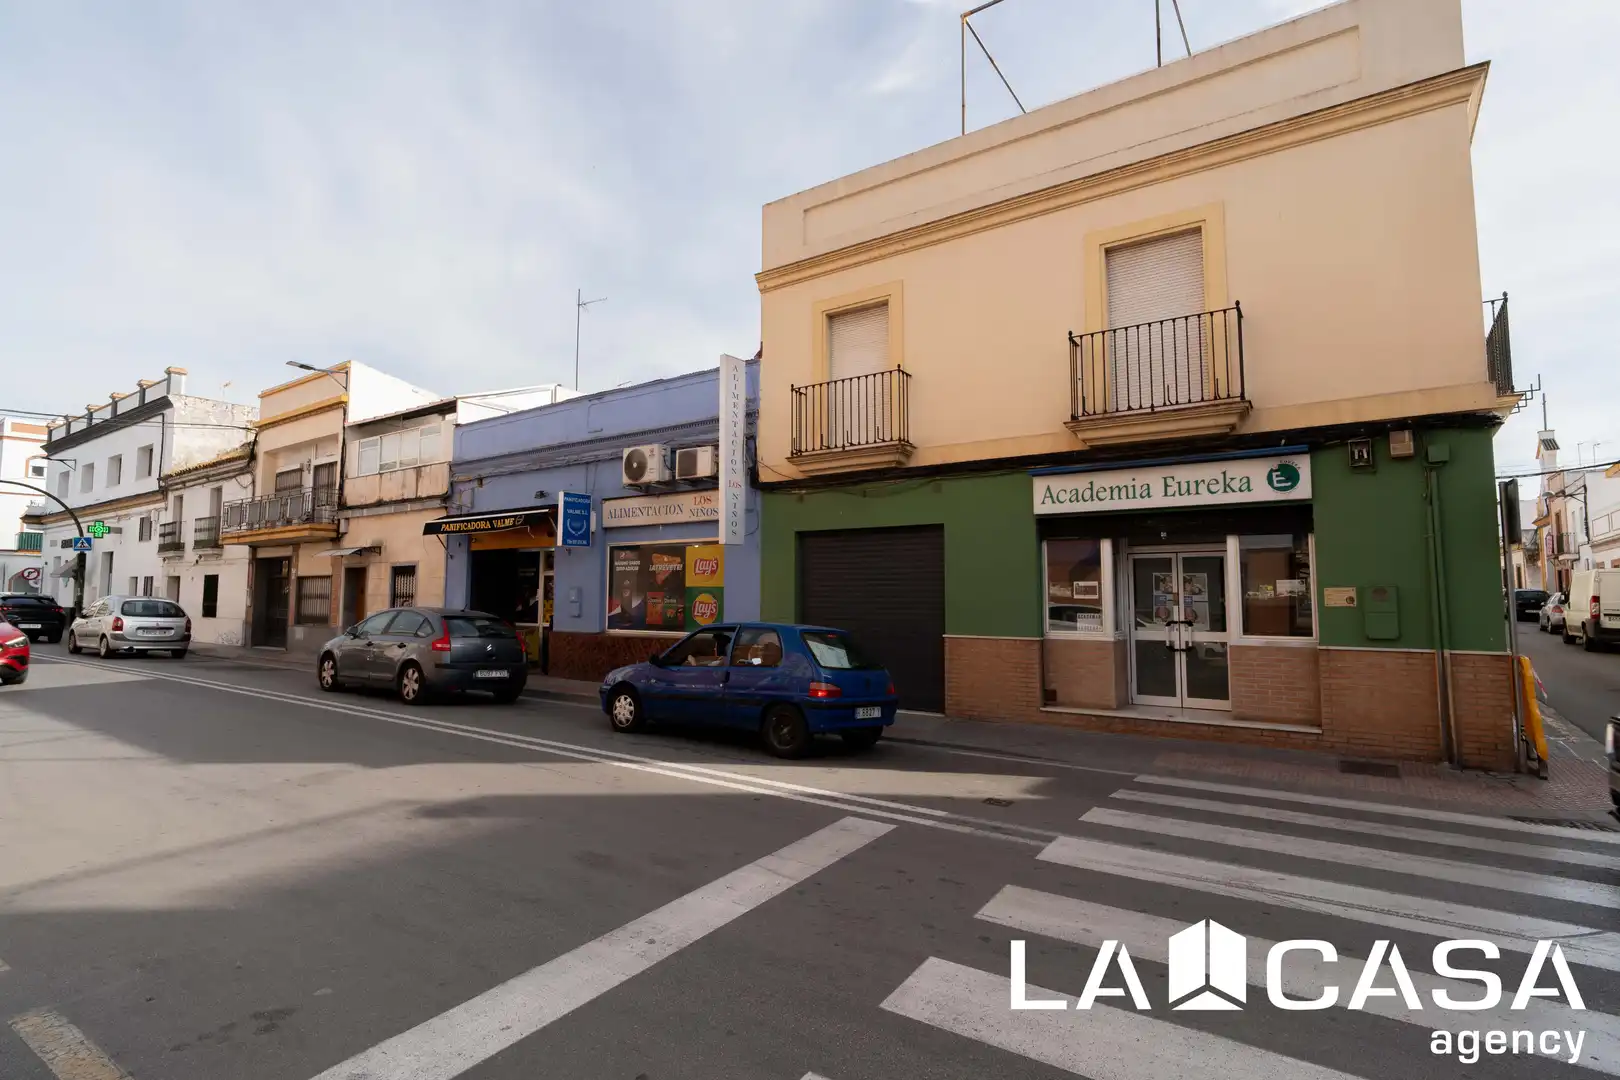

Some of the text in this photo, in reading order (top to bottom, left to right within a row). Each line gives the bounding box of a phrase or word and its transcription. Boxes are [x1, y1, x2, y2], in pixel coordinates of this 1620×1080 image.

[728, 479, 742, 488] LOS
[1040, 470, 1254, 505] Academia Eureka
[693, 495, 712, 505] LOS
[607, 504, 684, 519] ALIMENTACION
[689, 506, 719, 518] NIÑOS
[440, 517, 515, 532] PANIFICADORA VALME
[695, 557, 718, 575] Lay's
[694, 600, 717, 618] Lay's
